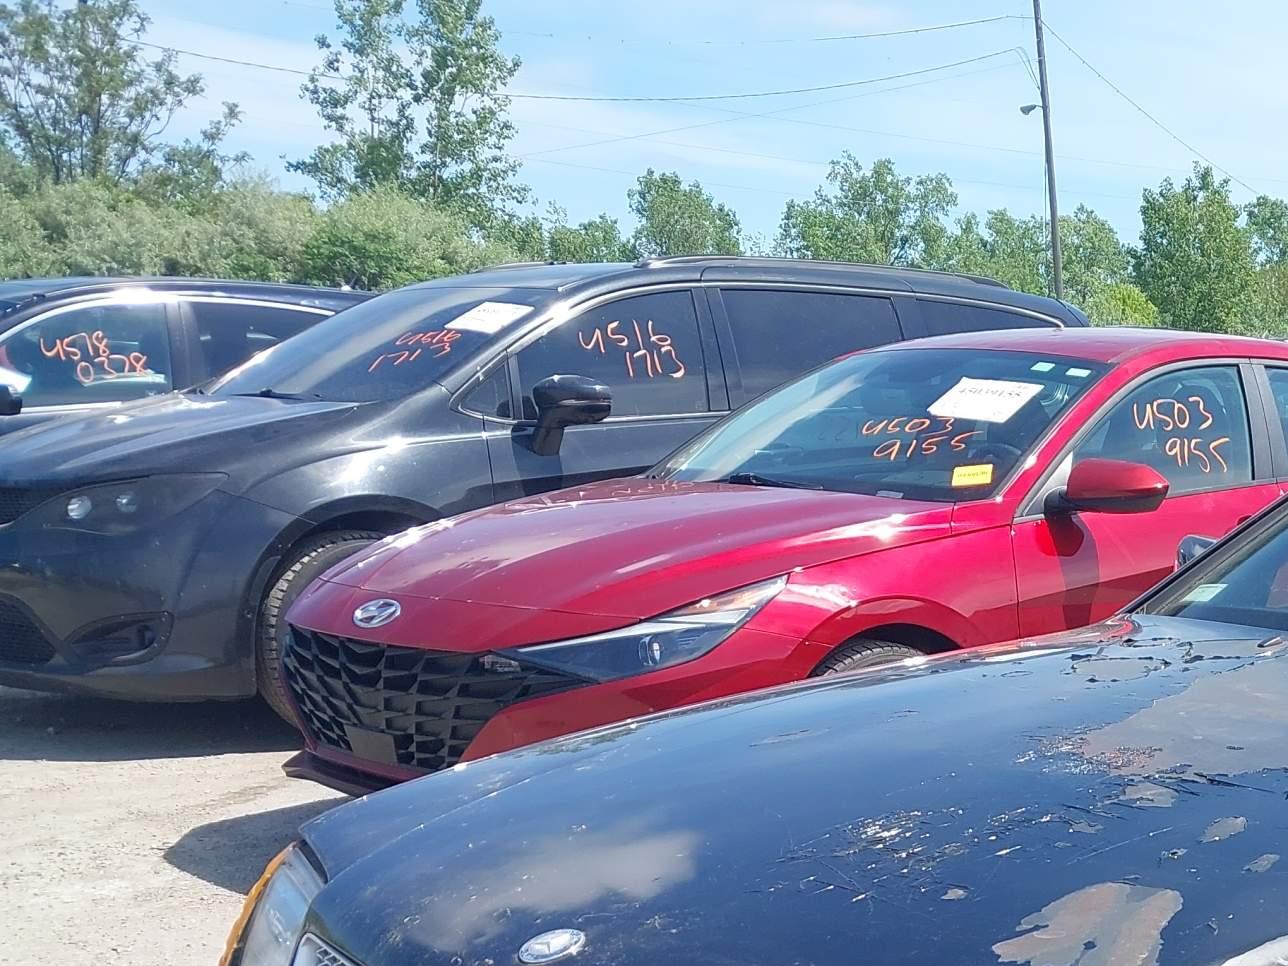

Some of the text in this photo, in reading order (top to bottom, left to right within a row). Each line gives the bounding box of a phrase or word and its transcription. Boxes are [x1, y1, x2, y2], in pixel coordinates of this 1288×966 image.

[40, 330, 110, 361] 4578
[579, 319, 672, 353] 4516
[76, 351, 148, 383] 0378
[367, 342, 452, 373] 1713
[625, 345, 686, 378] 1713
[862, 416, 955, 437] 4503
[1133, 396, 1213, 431] 4503
[873, 430, 985, 461] 9155
[1165, 437, 1231, 473] 9155
